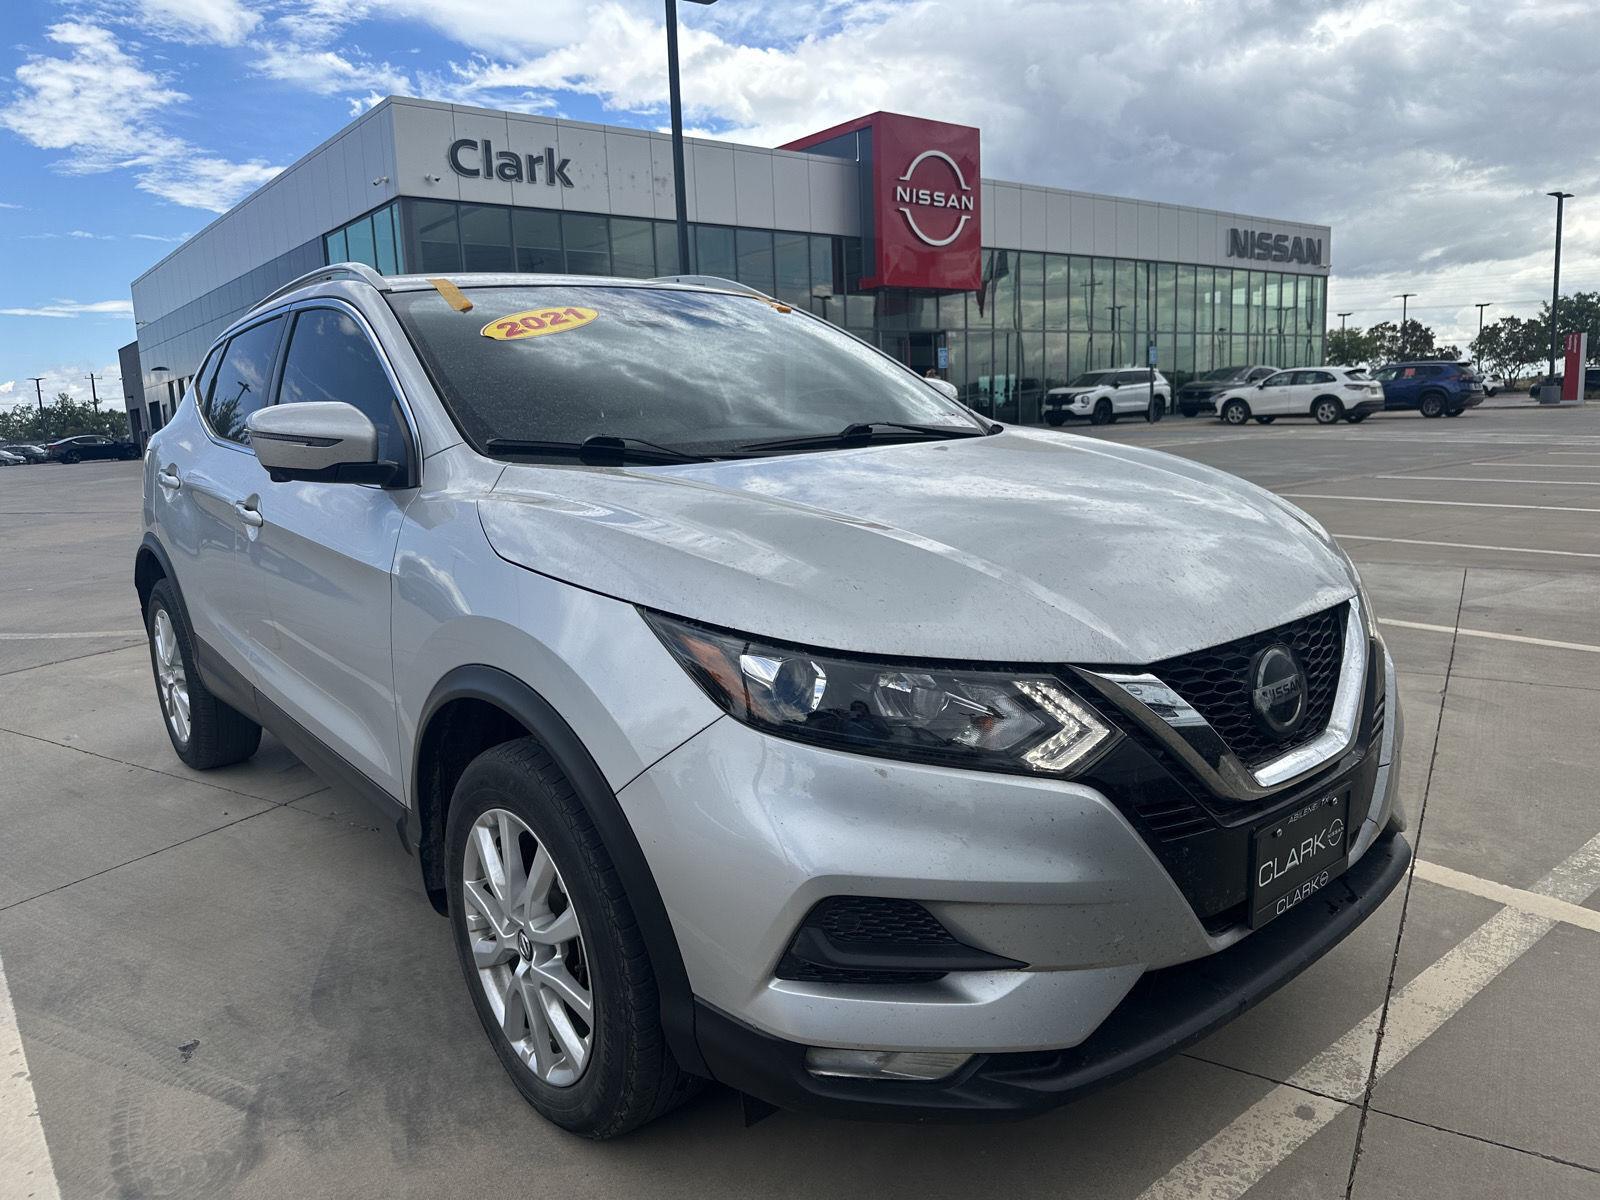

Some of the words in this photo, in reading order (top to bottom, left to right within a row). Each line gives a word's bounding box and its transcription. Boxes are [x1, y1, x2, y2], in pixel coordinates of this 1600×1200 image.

[448, 138, 575, 189] Clark
[896, 185, 974, 211] NISSAN
[1227, 228, 1322, 266] NISSAN
[496, 308, 587, 338] 2021
[1261, 676, 1303, 700] NISSAN
[1258, 828, 1327, 888] CLARK
[1276, 875, 1320, 915] CLARK
